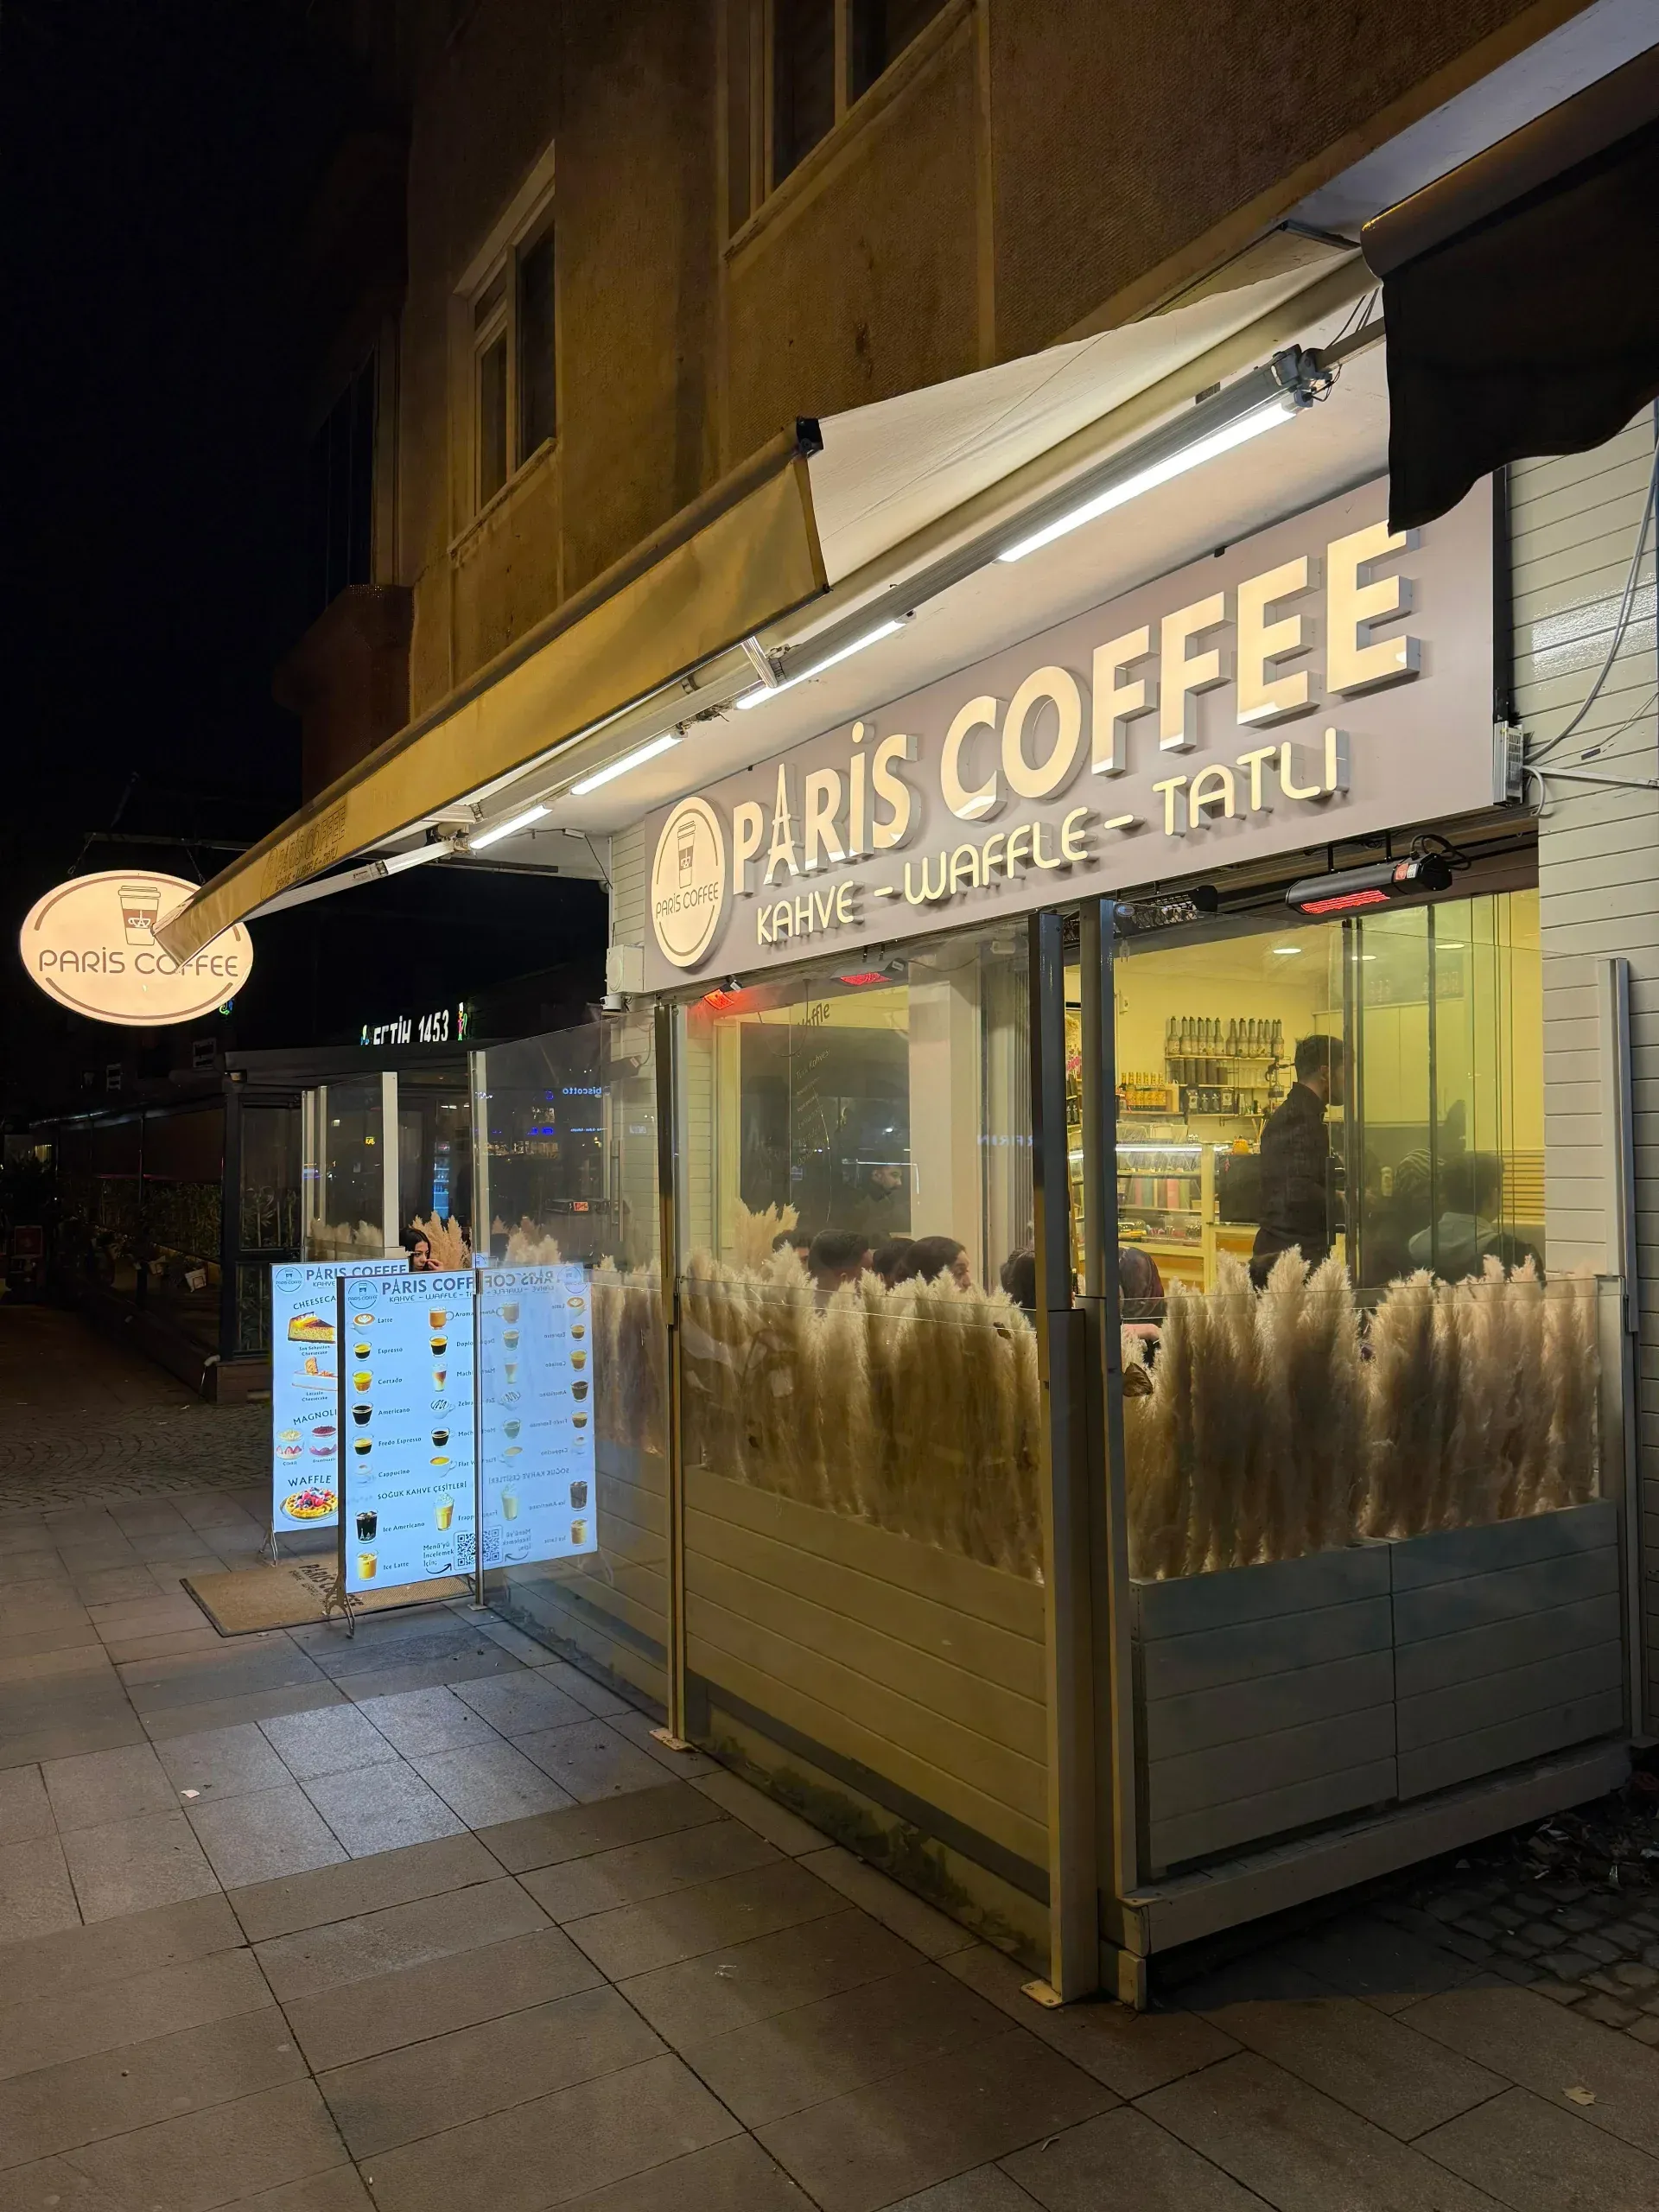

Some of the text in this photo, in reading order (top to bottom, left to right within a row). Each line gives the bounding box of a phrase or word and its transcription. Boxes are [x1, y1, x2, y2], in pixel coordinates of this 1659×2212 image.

[941, 518, 1420, 823] COFFEE
[757, 880, 856, 946] KAHVE
[905, 806, 1089, 906] WAFFLE
[1152, 727, 1338, 836] TATLI
[683, 881, 719, 910] COFFEE
[418, 1009, 449, 1043] 1453
[433, 1277, 474, 1291] COFF
[293, 1295, 336, 1310] CHEESECA
[288, 1475, 332, 1487] WAFFLE
[378, 1469, 410, 1478] Cappucino
[378, 1481, 467, 1500] SOĞUK KAHVE ÇEŞİTLERİ
[393, 1522, 425, 1531] Americano
